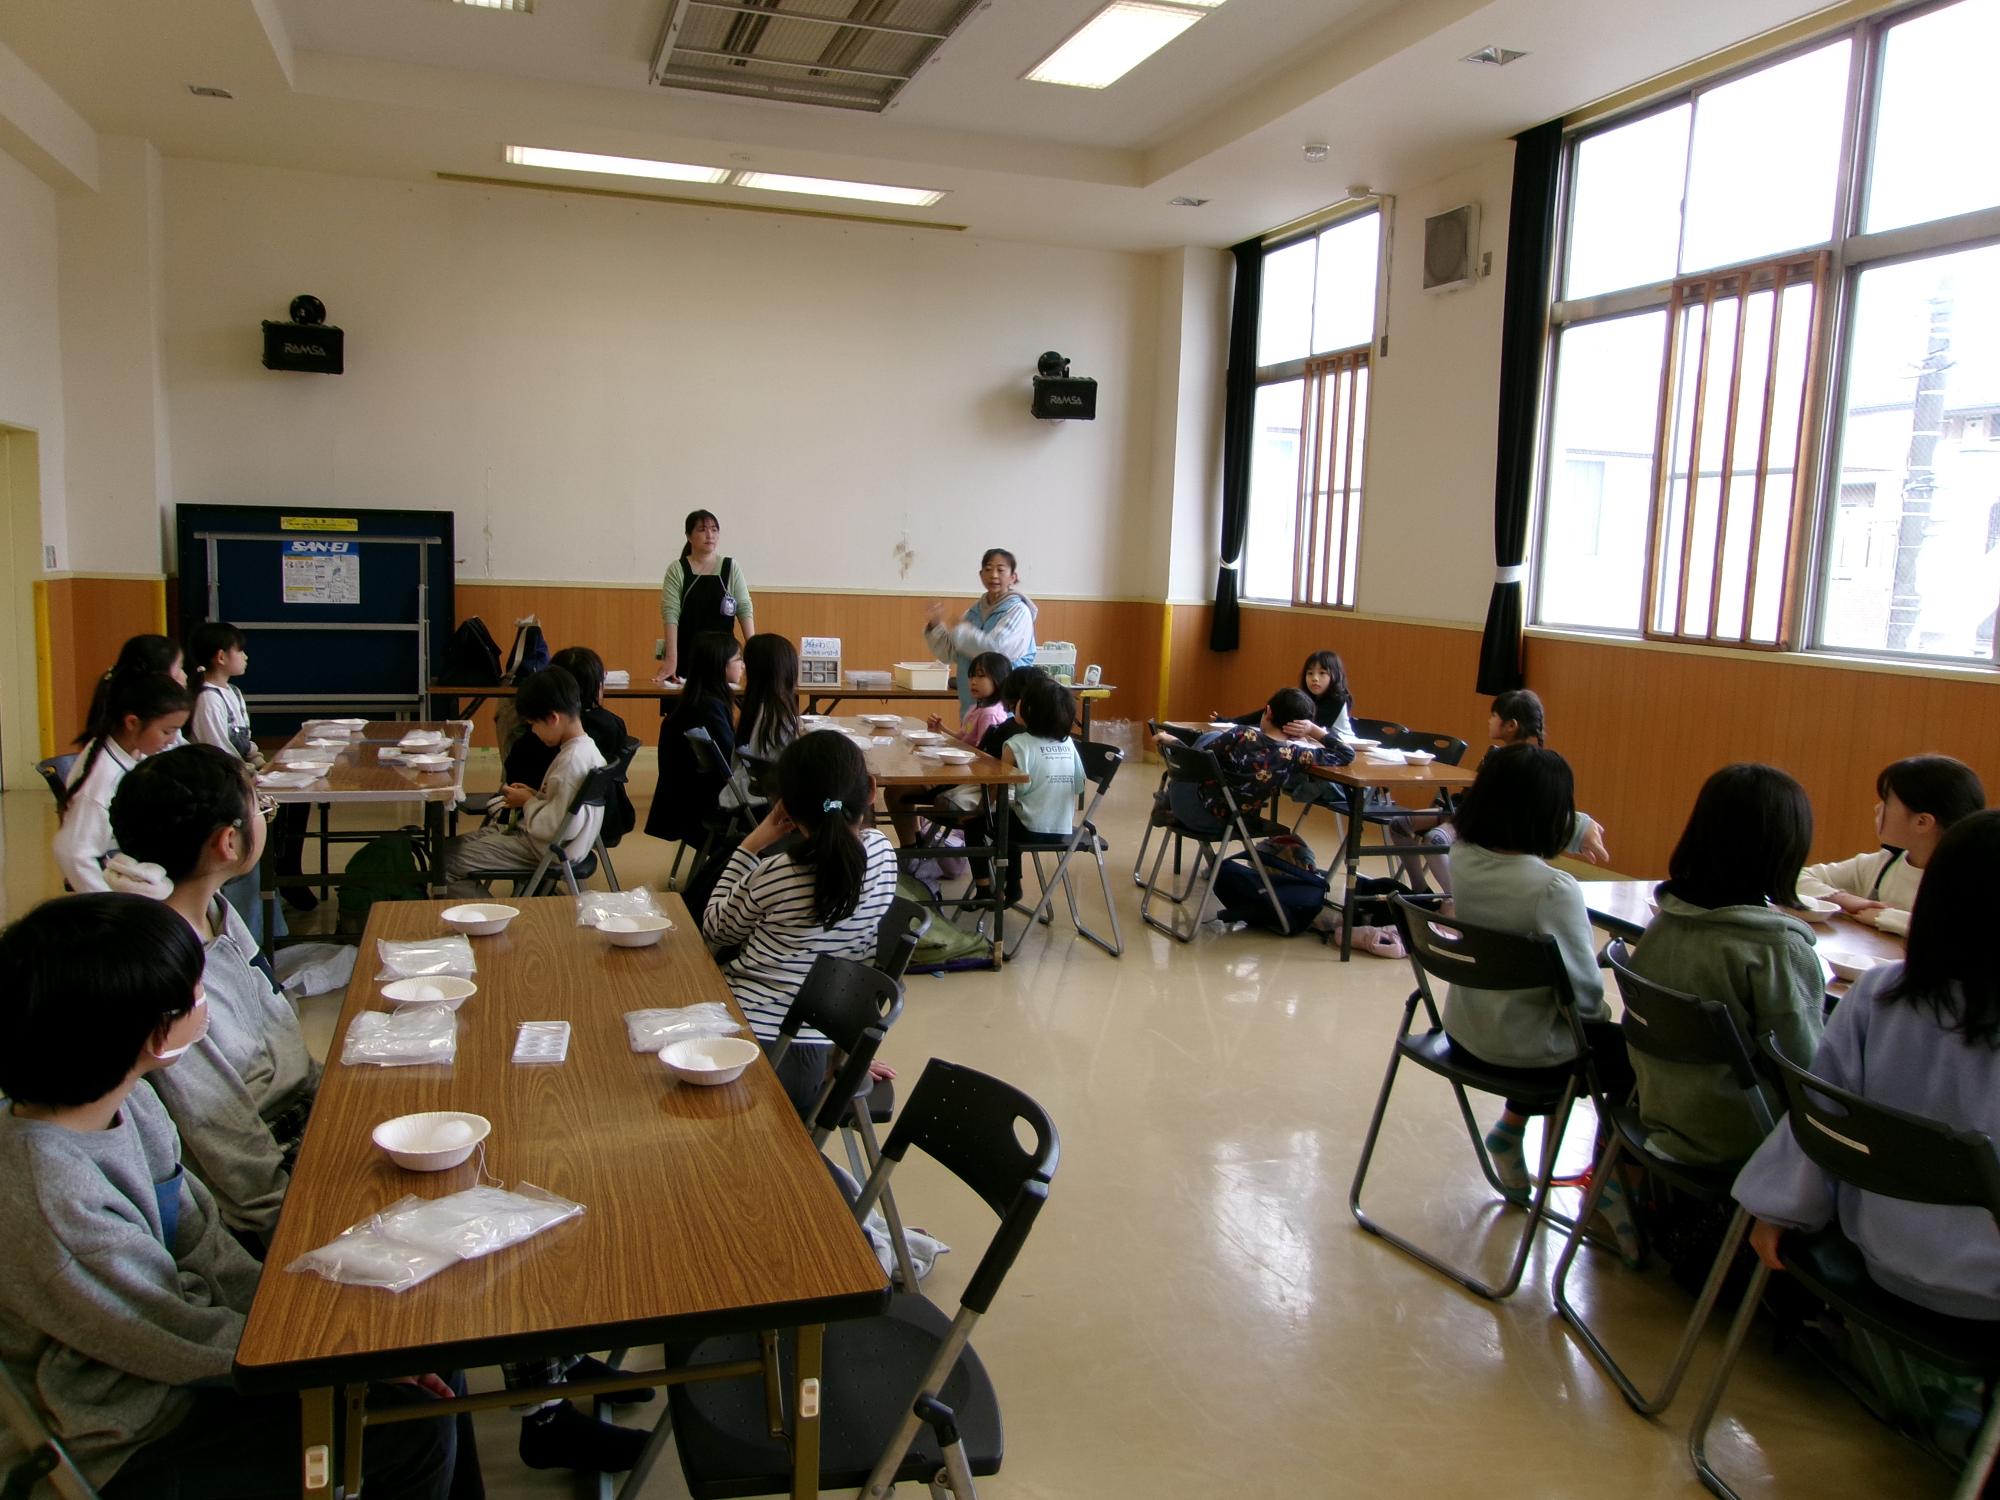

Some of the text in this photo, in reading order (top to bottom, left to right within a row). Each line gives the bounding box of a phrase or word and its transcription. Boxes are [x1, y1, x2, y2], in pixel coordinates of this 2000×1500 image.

[284, 342, 326, 356] RAMSA
[1049, 395, 1083, 405] RAMSA
[291, 541, 349, 553] SAN-EI
